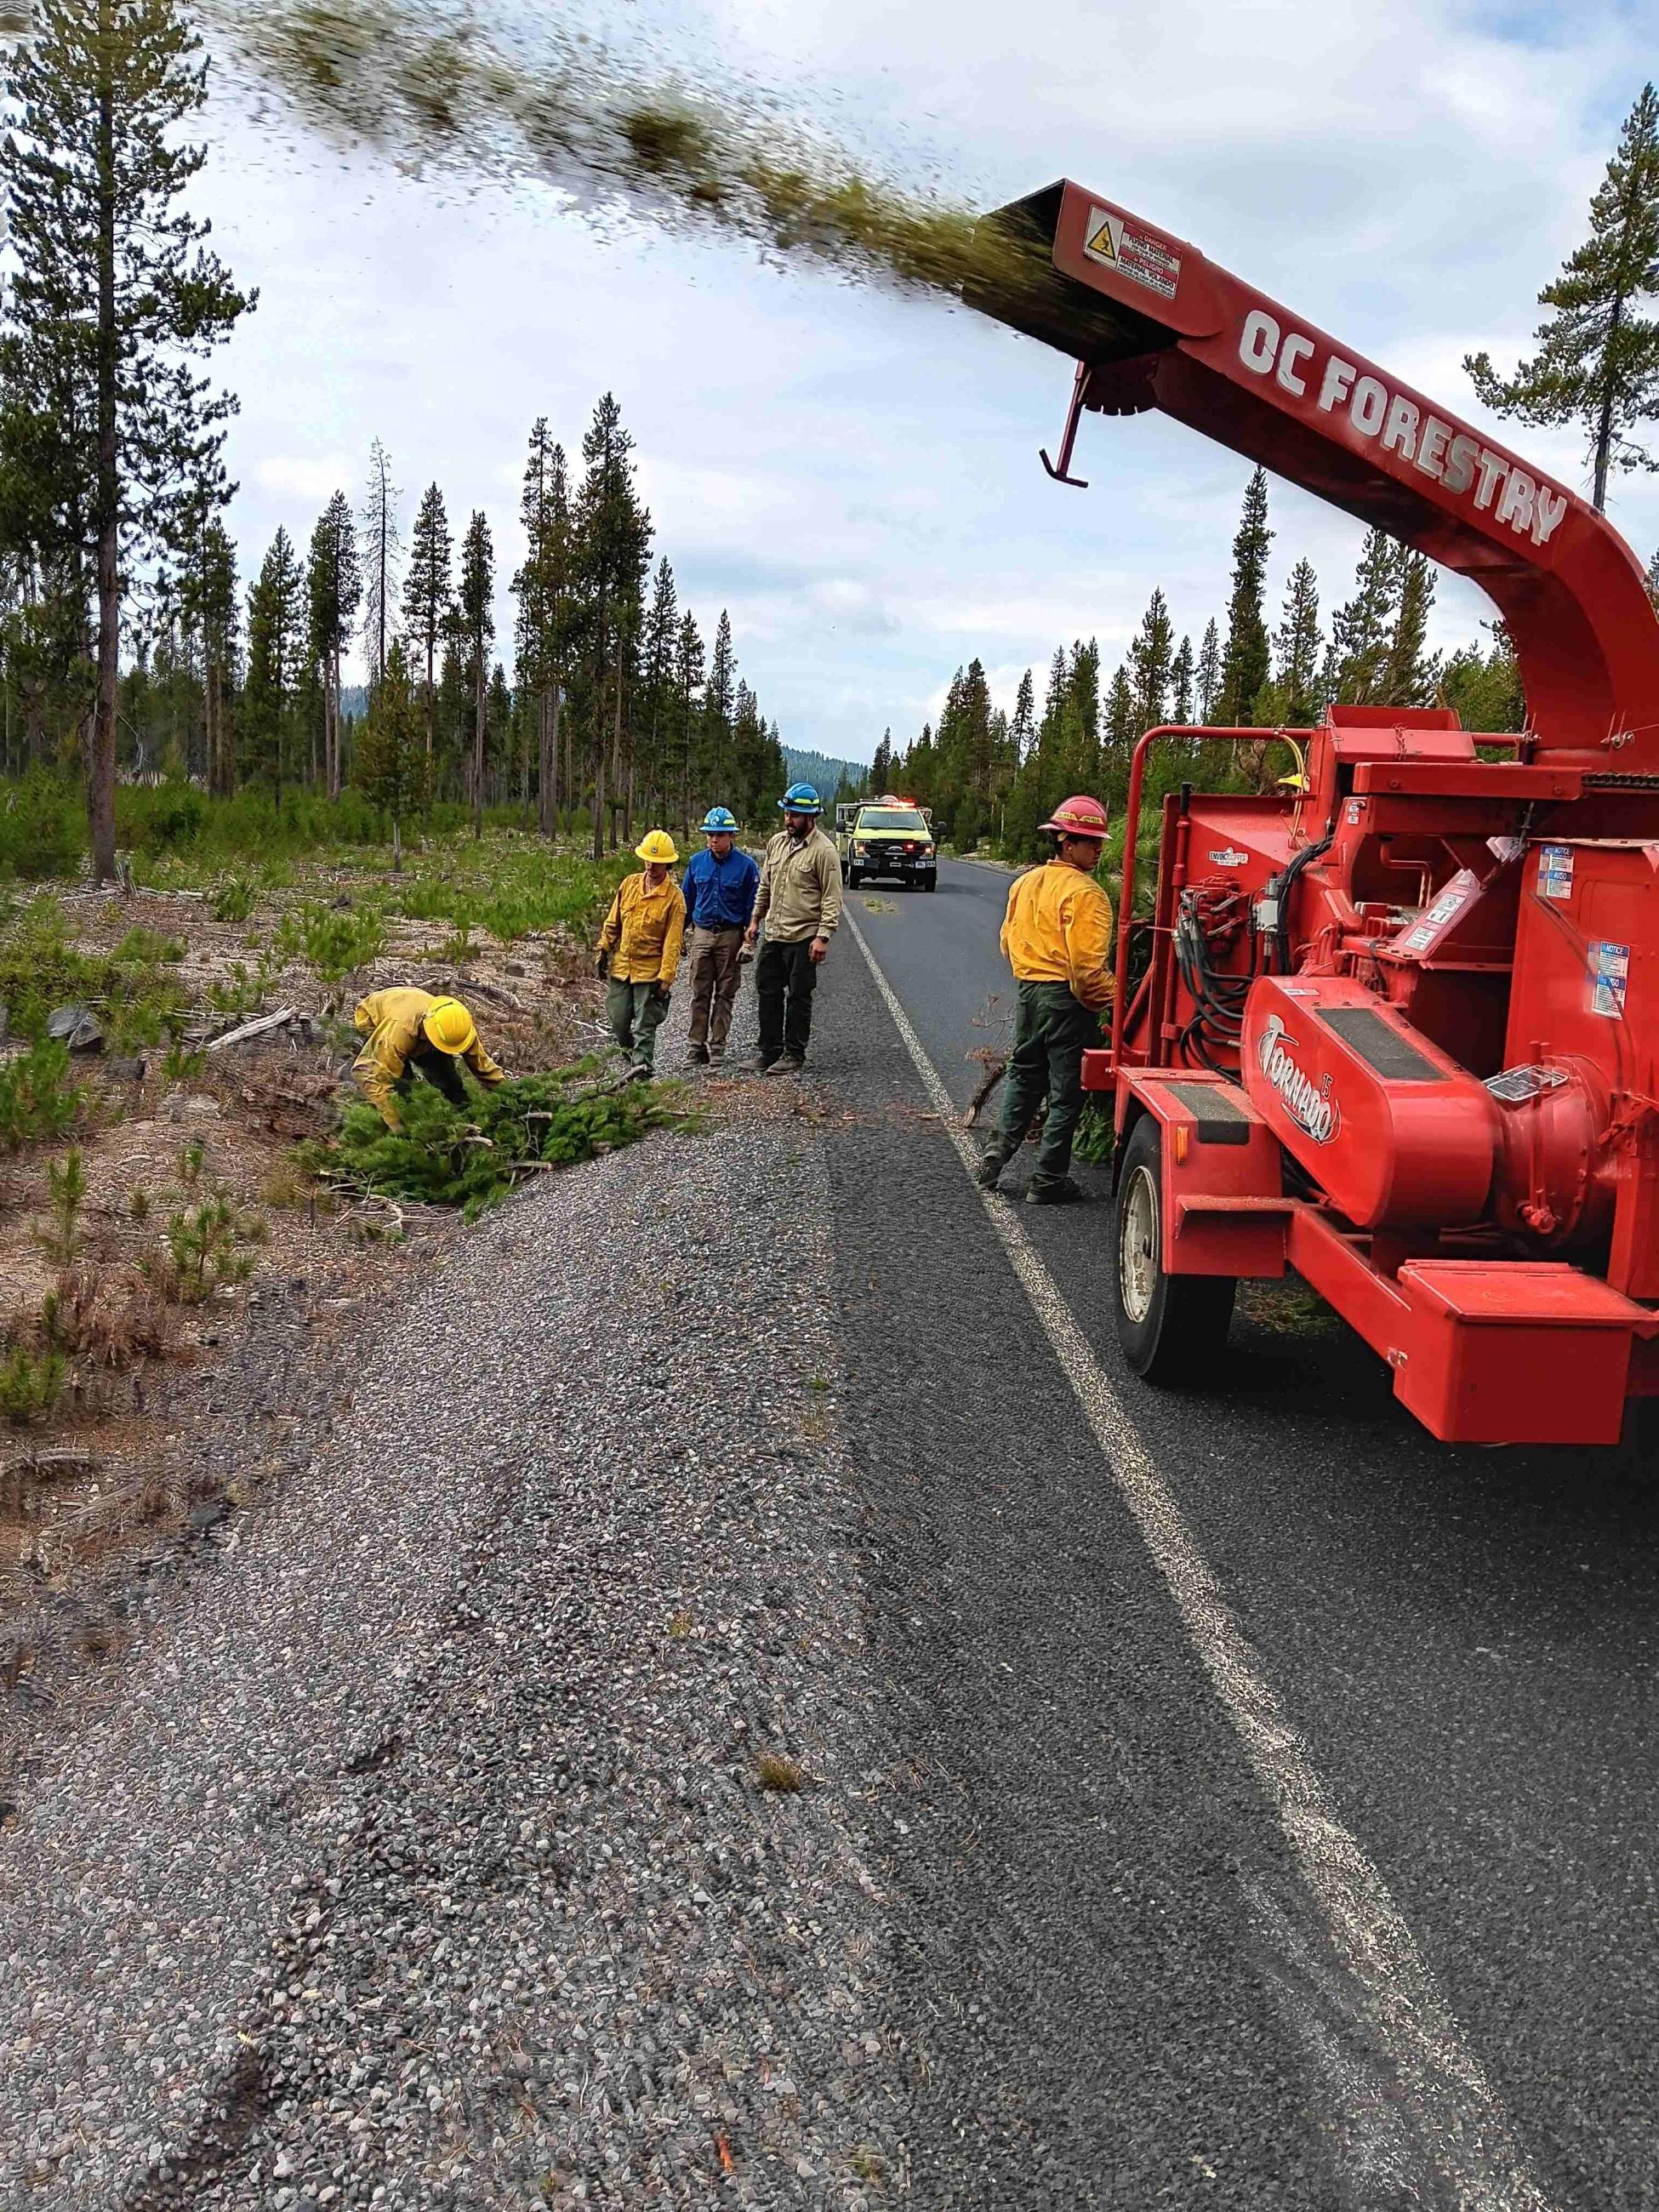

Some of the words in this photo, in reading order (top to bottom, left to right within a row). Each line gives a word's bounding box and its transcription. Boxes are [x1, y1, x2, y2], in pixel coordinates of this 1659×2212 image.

[1129, 236, 1147, 249] FLYING
[1149, 246, 1173, 263] MATERIAL
[1144, 235, 1166, 251] DANGER
[1120, 257, 1146, 275] MATERIAL
[1149, 272, 1173, 288] VOLANDO
[1139, 258, 1163, 274] PELIGRO
[1240, 310, 1314, 396] OC
[1318, 356, 1567, 545] FORESTRY
[1605, 944, 1623, 954] NOTICE
[1259, 1013, 1333, 1141] TORNADO
[1322, 1074, 1333, 1099] 15
